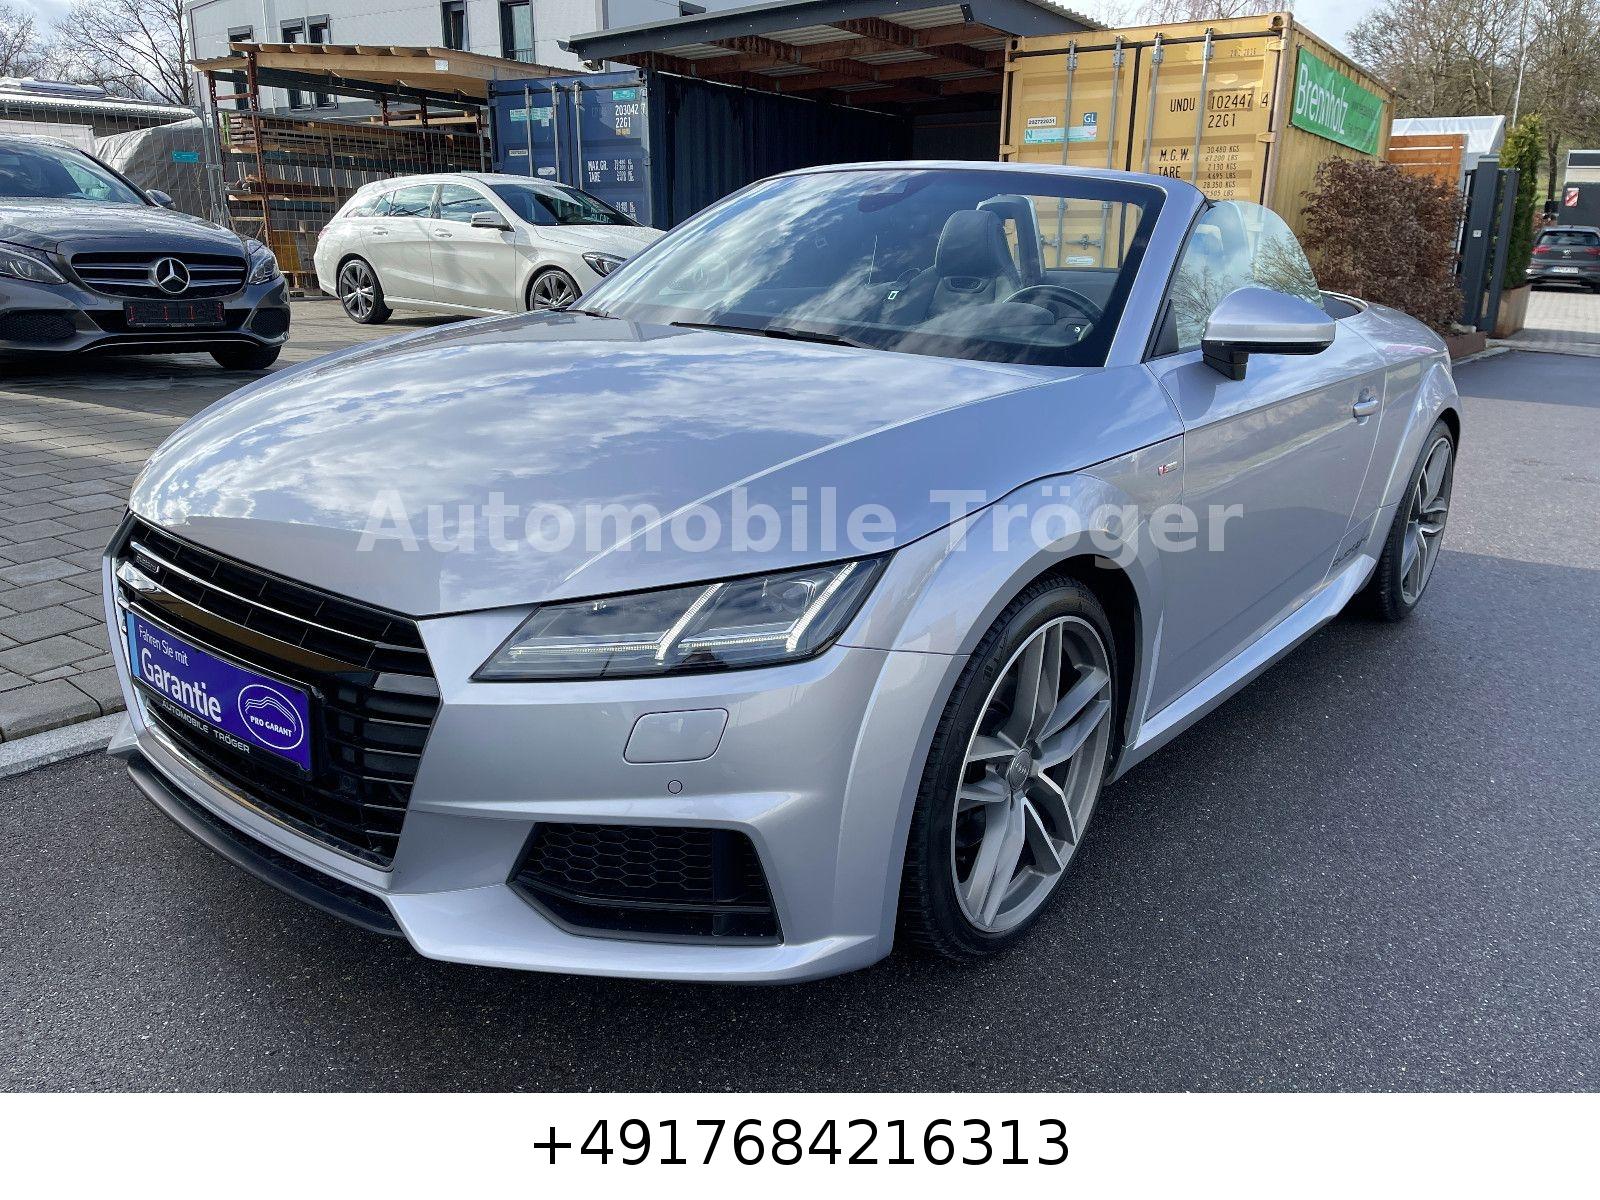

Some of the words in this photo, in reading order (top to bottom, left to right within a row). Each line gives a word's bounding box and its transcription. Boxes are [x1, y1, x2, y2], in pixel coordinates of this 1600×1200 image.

[1170, 98, 1196, 112] UNDU
[1211, 93, 1253, 110] 102447
[1261, 93, 1269, 107] 4
[1296, 62, 1348, 135] Brennholz
[615, 104, 639, 116] 203042
[1084, 113, 1097, 123] GL
[615, 117, 631, 128] 22G1
[1208, 113, 1236, 128] 22G1
[588, 171, 601, 182] TARE
[1158, 165, 1181, 179] TARE
[138, 624, 162, 650] Fahren
[162, 639, 175, 659] Sie
[175, 648, 189, 667] mit
[141, 647, 222, 723] Garantie
[162, 700, 209, 733] AUTOMOBILE
[213, 728, 251, 754] TRÖGER
[250, 714, 264, 728] PRO
[264, 718, 293, 738] GARANT
